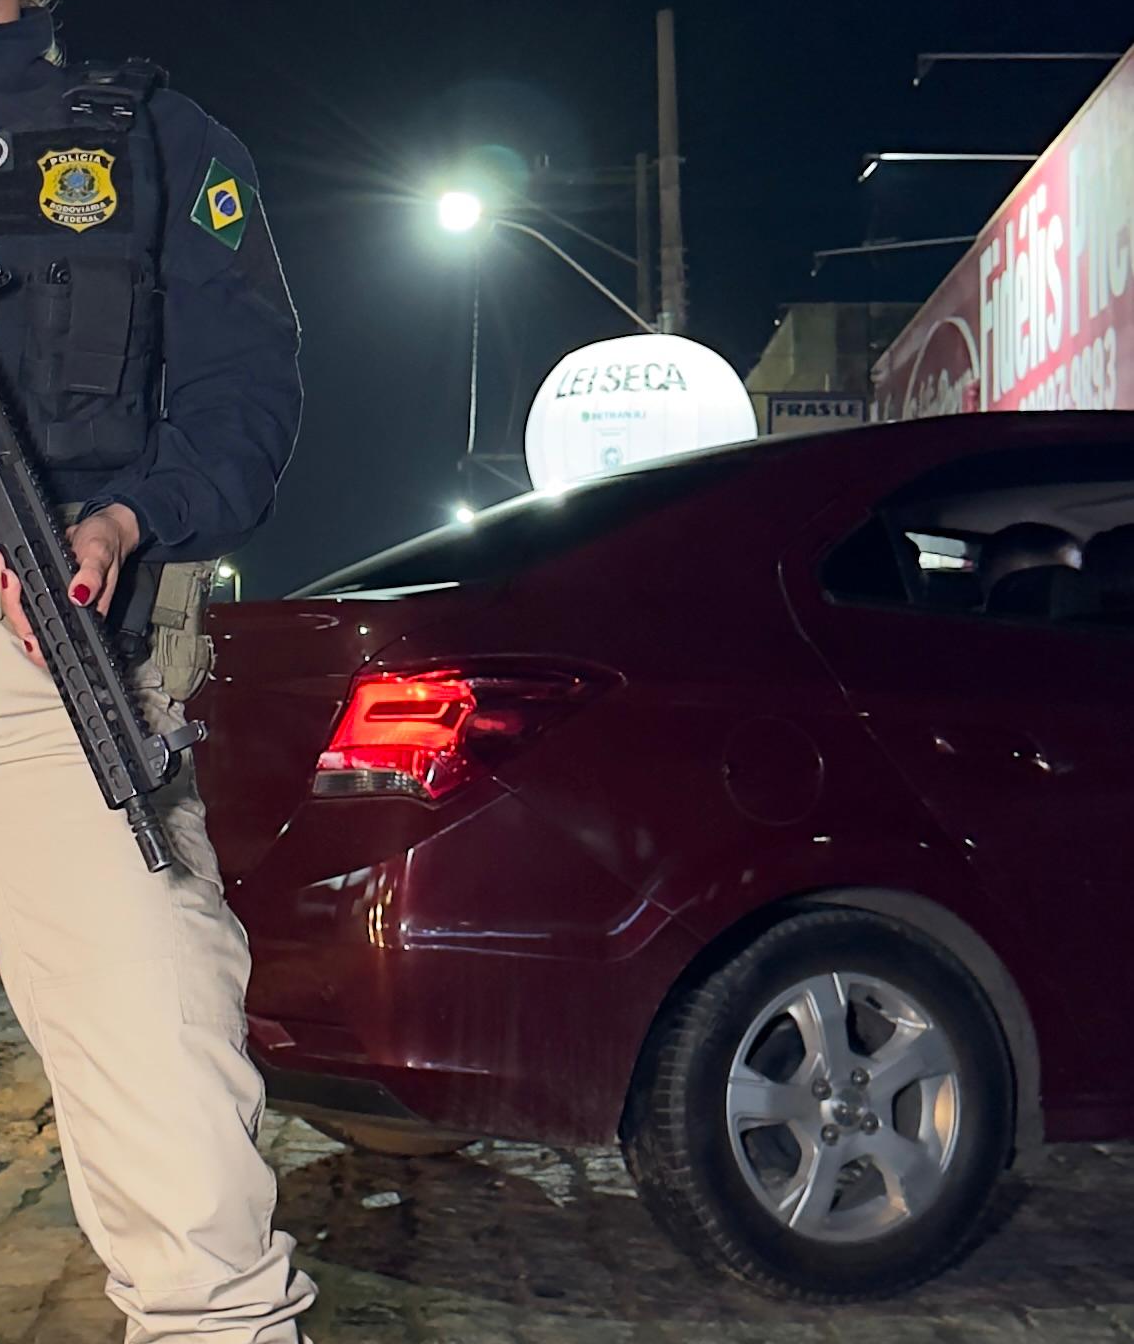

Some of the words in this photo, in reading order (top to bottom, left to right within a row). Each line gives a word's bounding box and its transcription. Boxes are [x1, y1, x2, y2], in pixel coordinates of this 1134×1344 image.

[58, 214, 100, 224] FEDERAL
[1069, 142, 1134, 337] Pne
[555, 366, 598, 400] LEI
[600, 362, 688, 393] SECA
